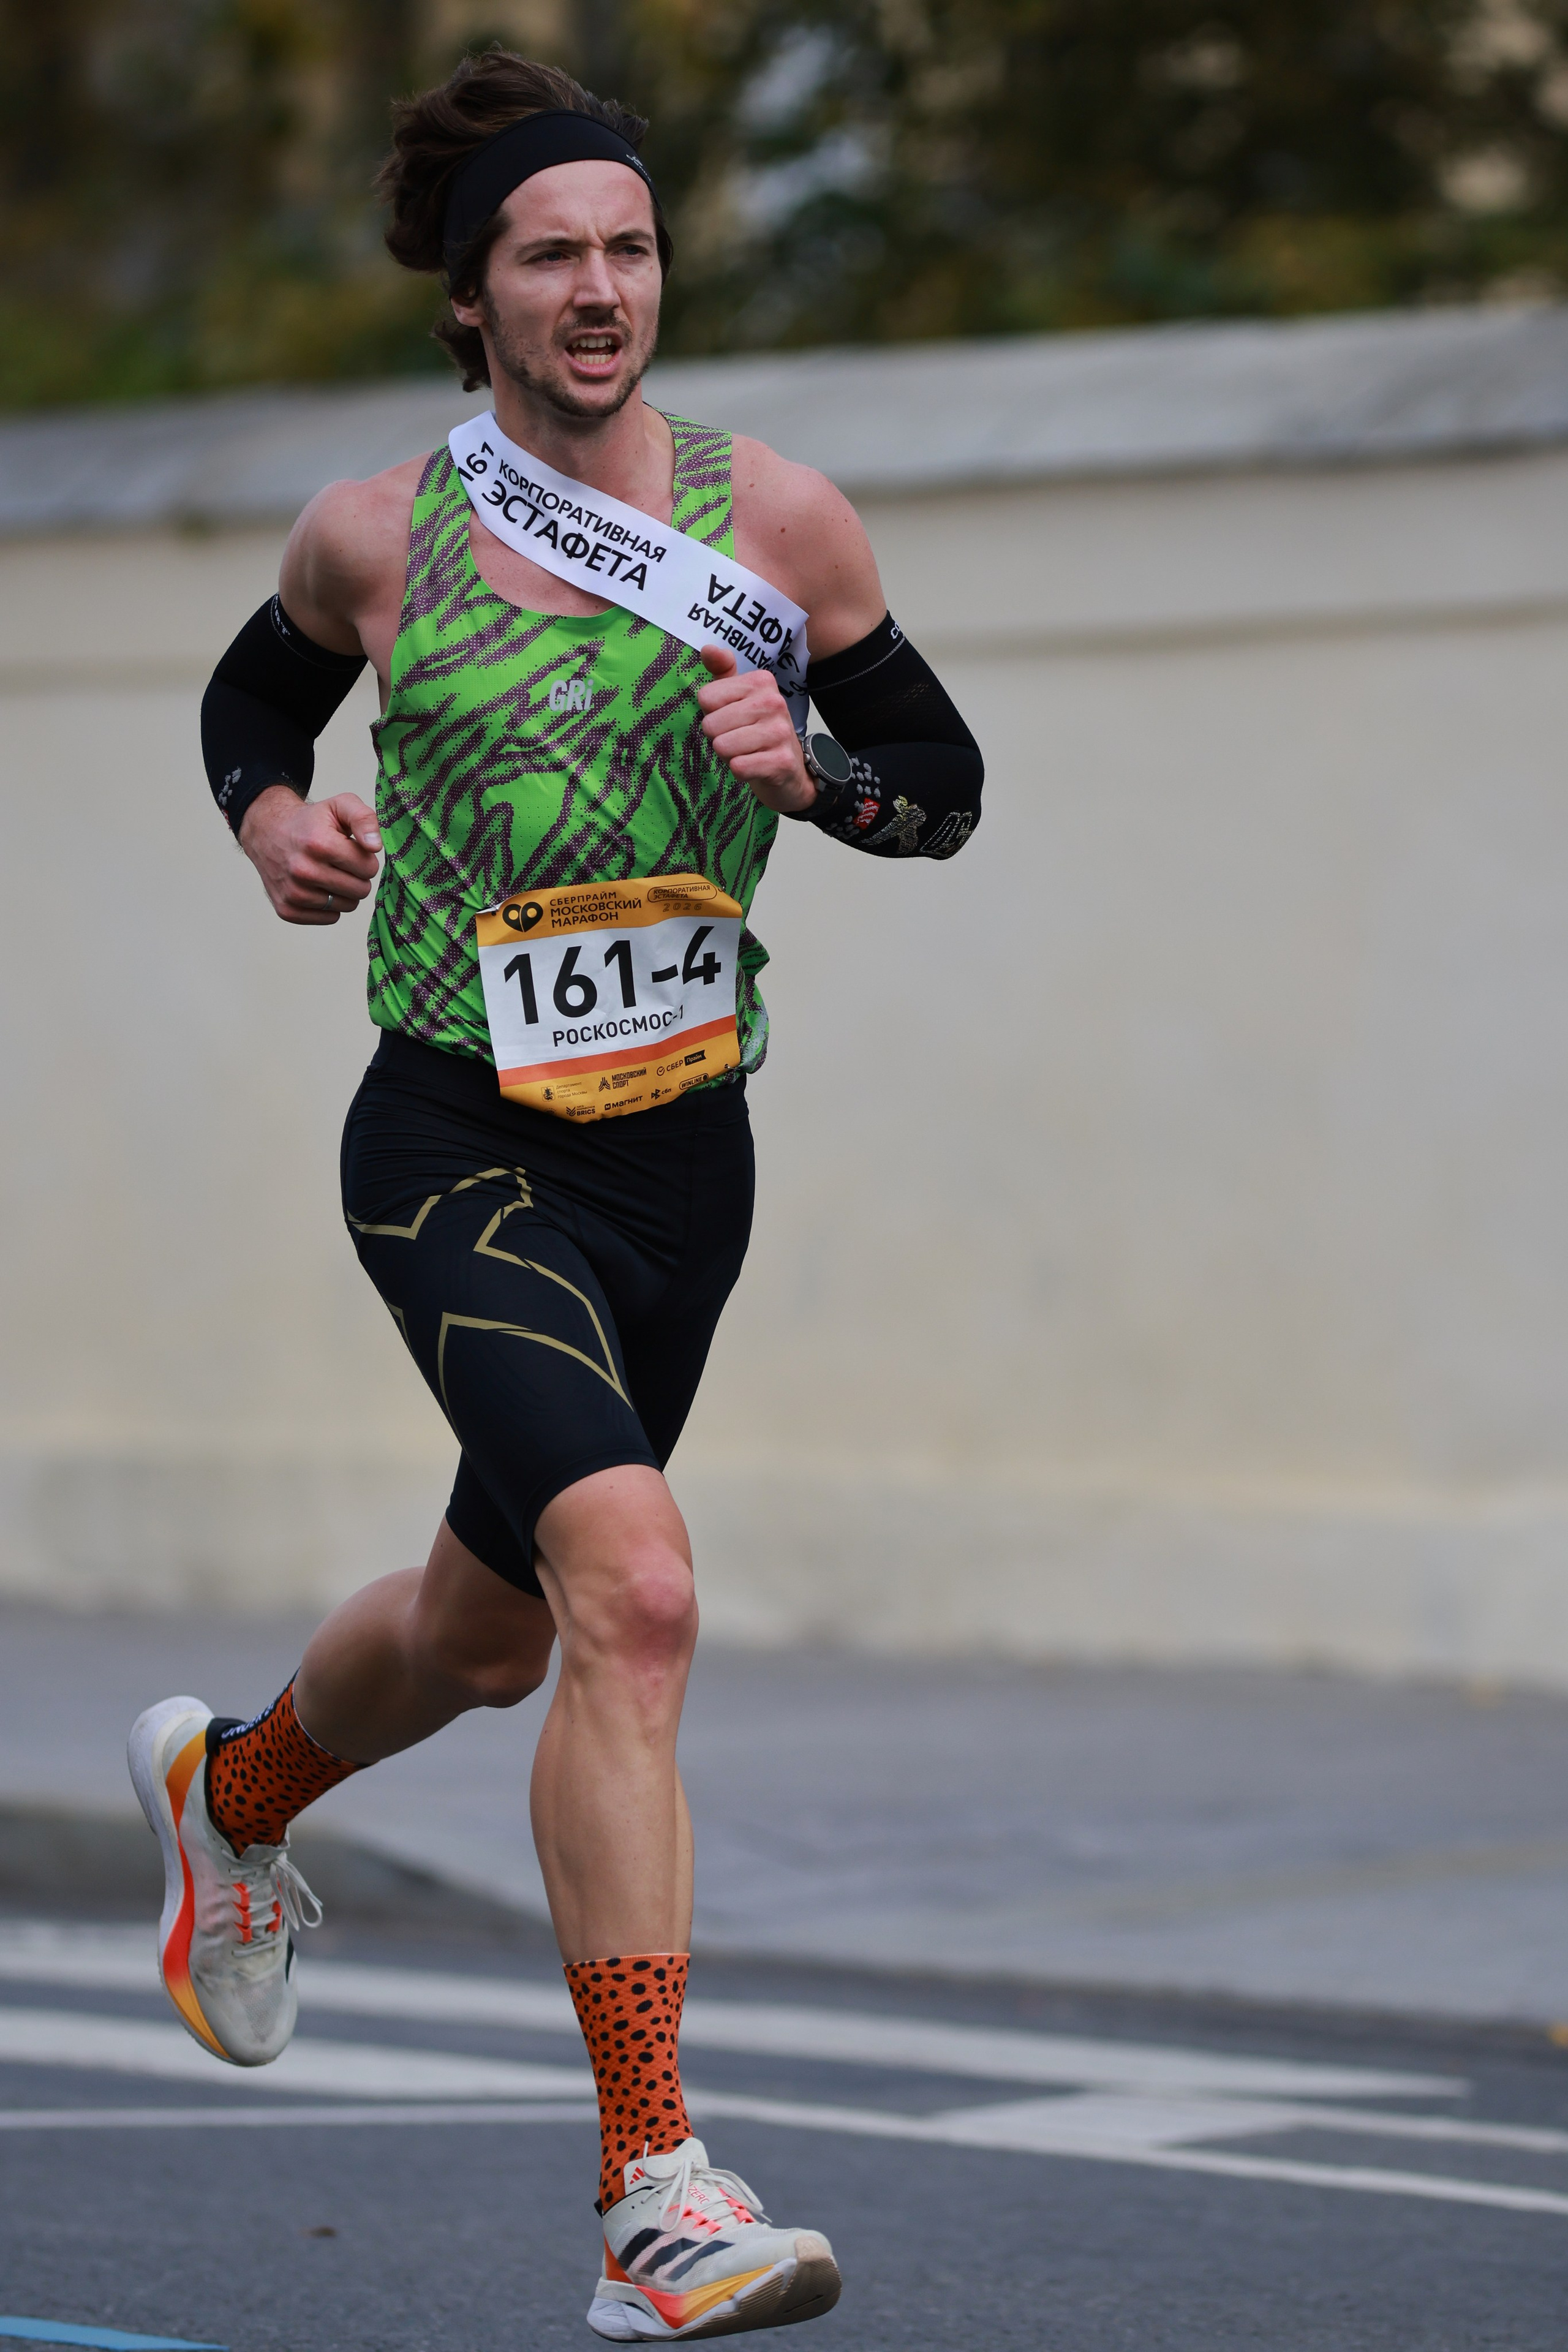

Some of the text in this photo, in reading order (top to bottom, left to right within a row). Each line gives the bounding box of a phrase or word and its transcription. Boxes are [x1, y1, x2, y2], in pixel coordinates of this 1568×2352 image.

[499, 459, 666, 562] КОРПОРАТИВНАЯ
[481, 480, 649, 590] ЭСТАФЕТА
[654, 885, 710, 894] КОРПОРАТИВНАЯ
[550, 891, 616, 906] СБЕРПРАЙМ
[551, 897, 641, 917] МОСКОВСКИЙ
[552, 911, 618, 928] МАРАФОН
[503, 925, 722, 1025] 161-4
[552, 1005, 683, 1047] РОСКОСМОС-1
[666, 1054, 703, 1071] СБЕР Прайм
[612, 1067, 647, 1082] МОСКОВСКИЙ
[681, 1076, 703, 1088] WINLINE
[612, 1080, 629, 1089] СПОРТ
